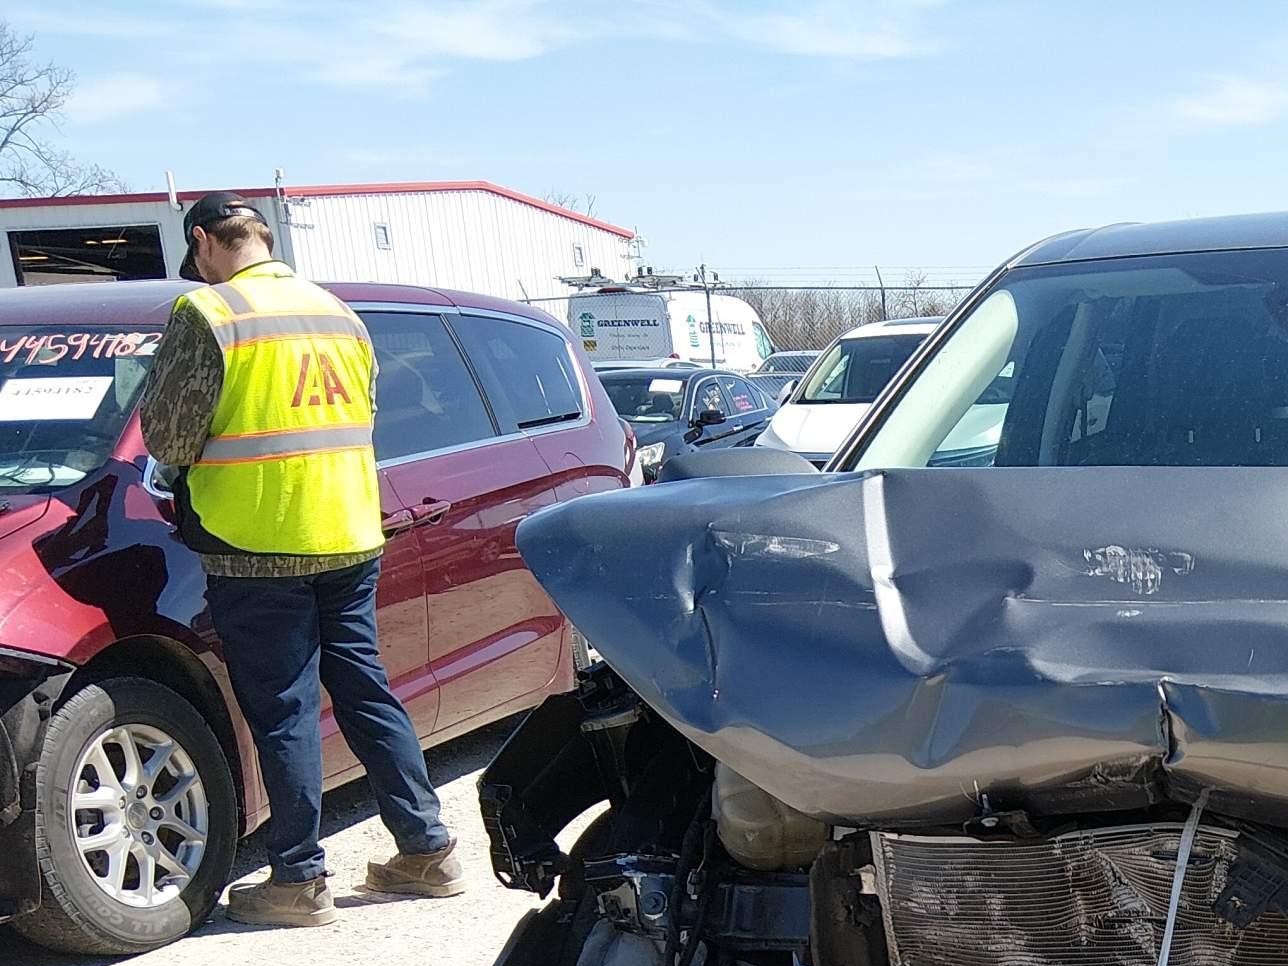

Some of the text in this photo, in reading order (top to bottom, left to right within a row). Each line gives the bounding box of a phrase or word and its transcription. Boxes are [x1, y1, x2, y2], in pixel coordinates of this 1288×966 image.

[597, 319, 660, 328] GREENWELL
[699, 321, 746, 335] GREENWELL
[0, 332, 163, 364] 44594182
